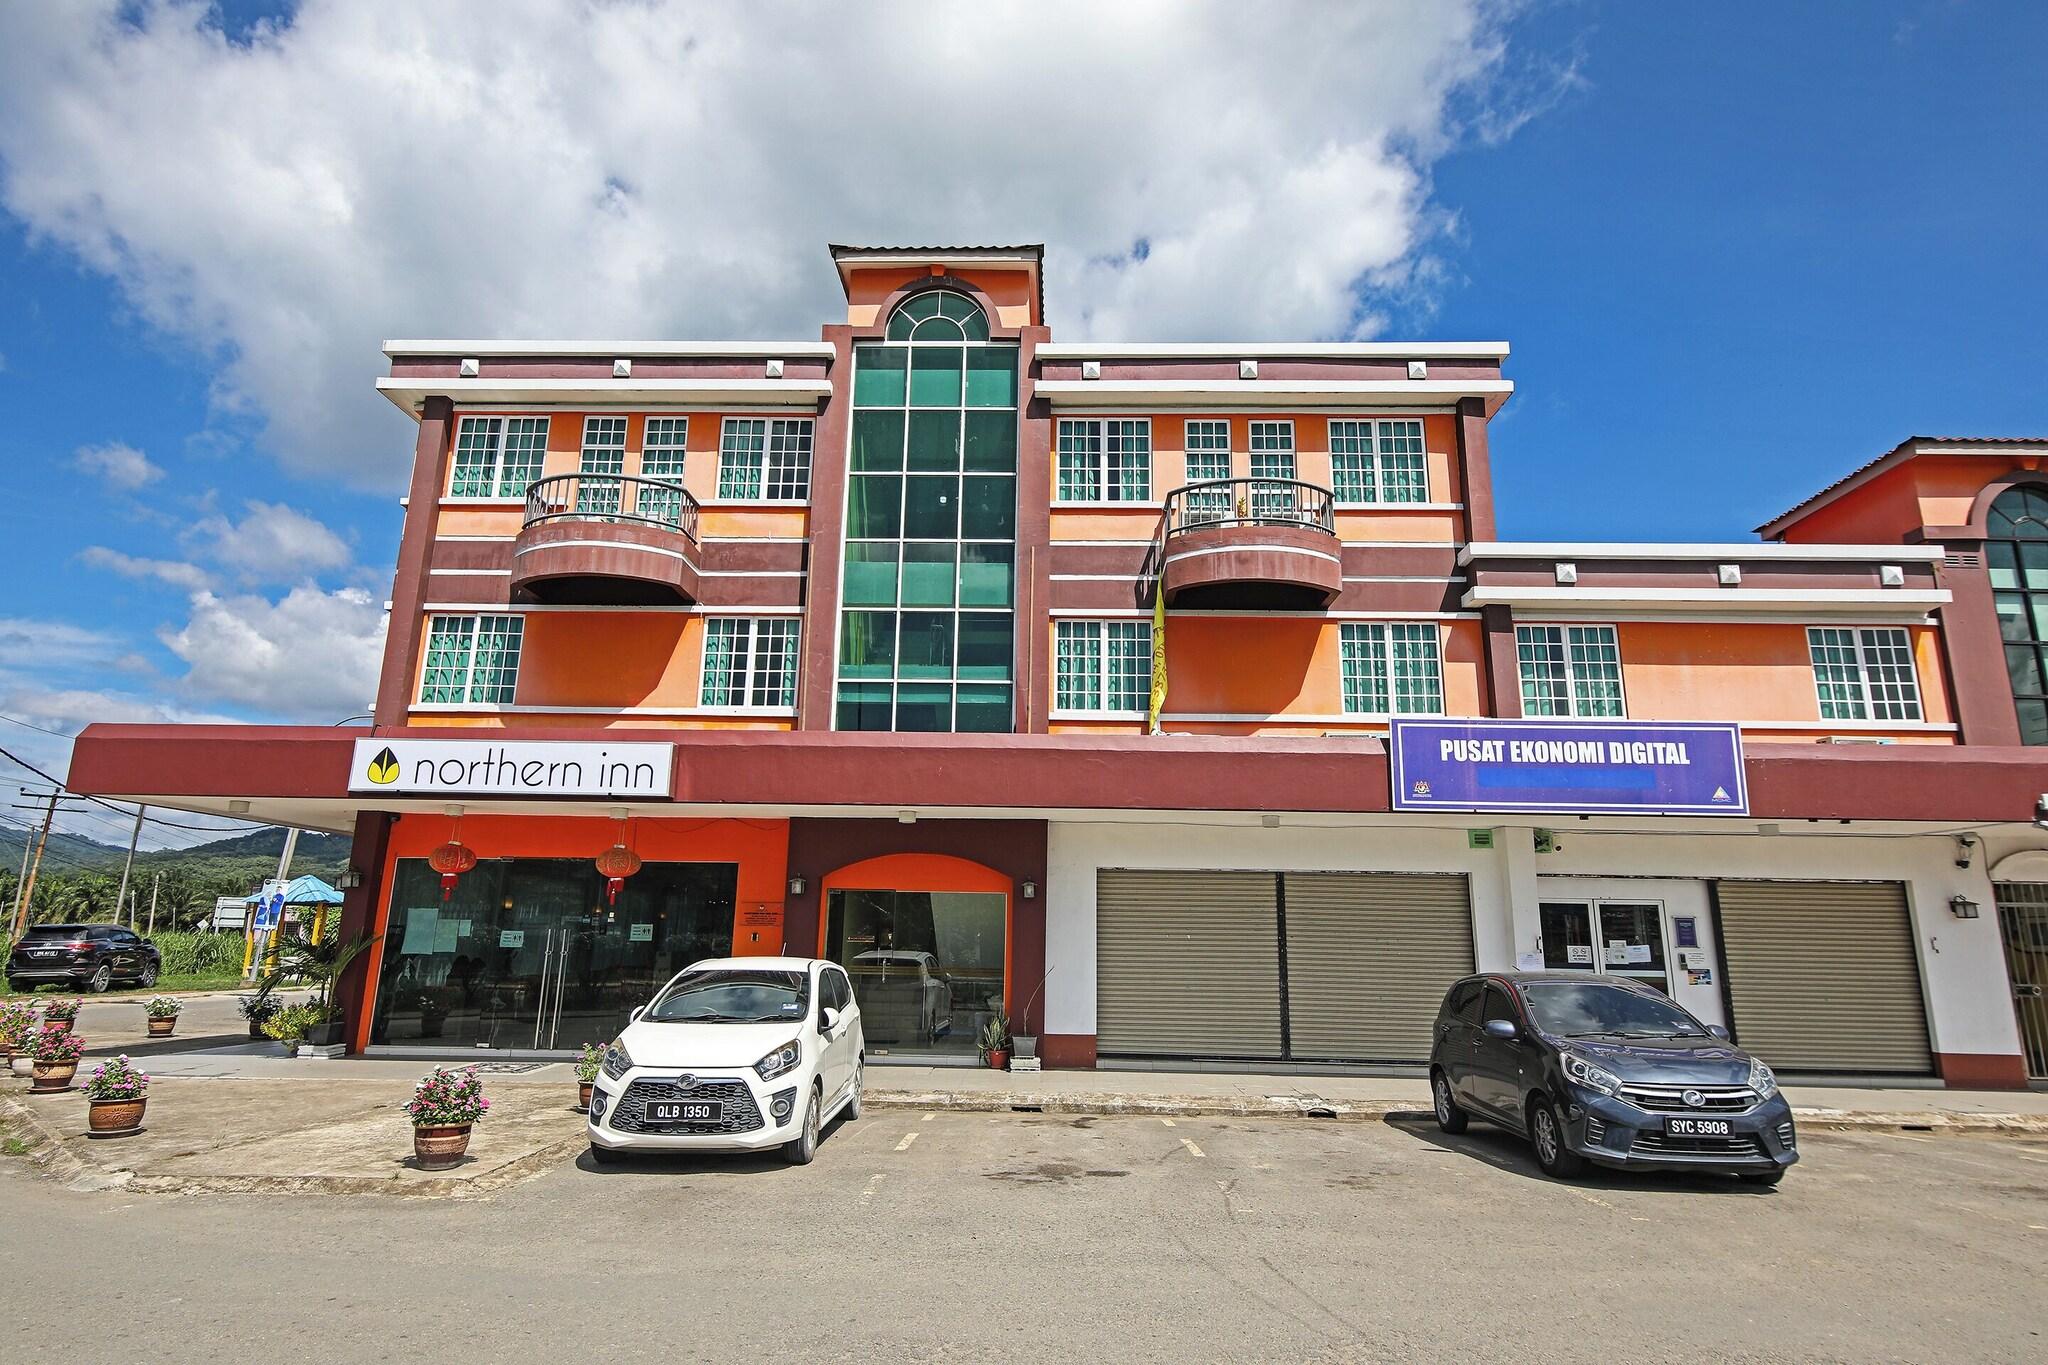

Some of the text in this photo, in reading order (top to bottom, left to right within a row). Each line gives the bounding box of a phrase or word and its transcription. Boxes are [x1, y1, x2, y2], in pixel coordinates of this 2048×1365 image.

[1440, 739, 1691, 764] PUSAT EKONOMI DIGITAL
[414, 747, 654, 789] northern inn
[657, 1105, 710, 1118] QLB 1350
[1671, 1119, 1729, 1135] SYC 5908
